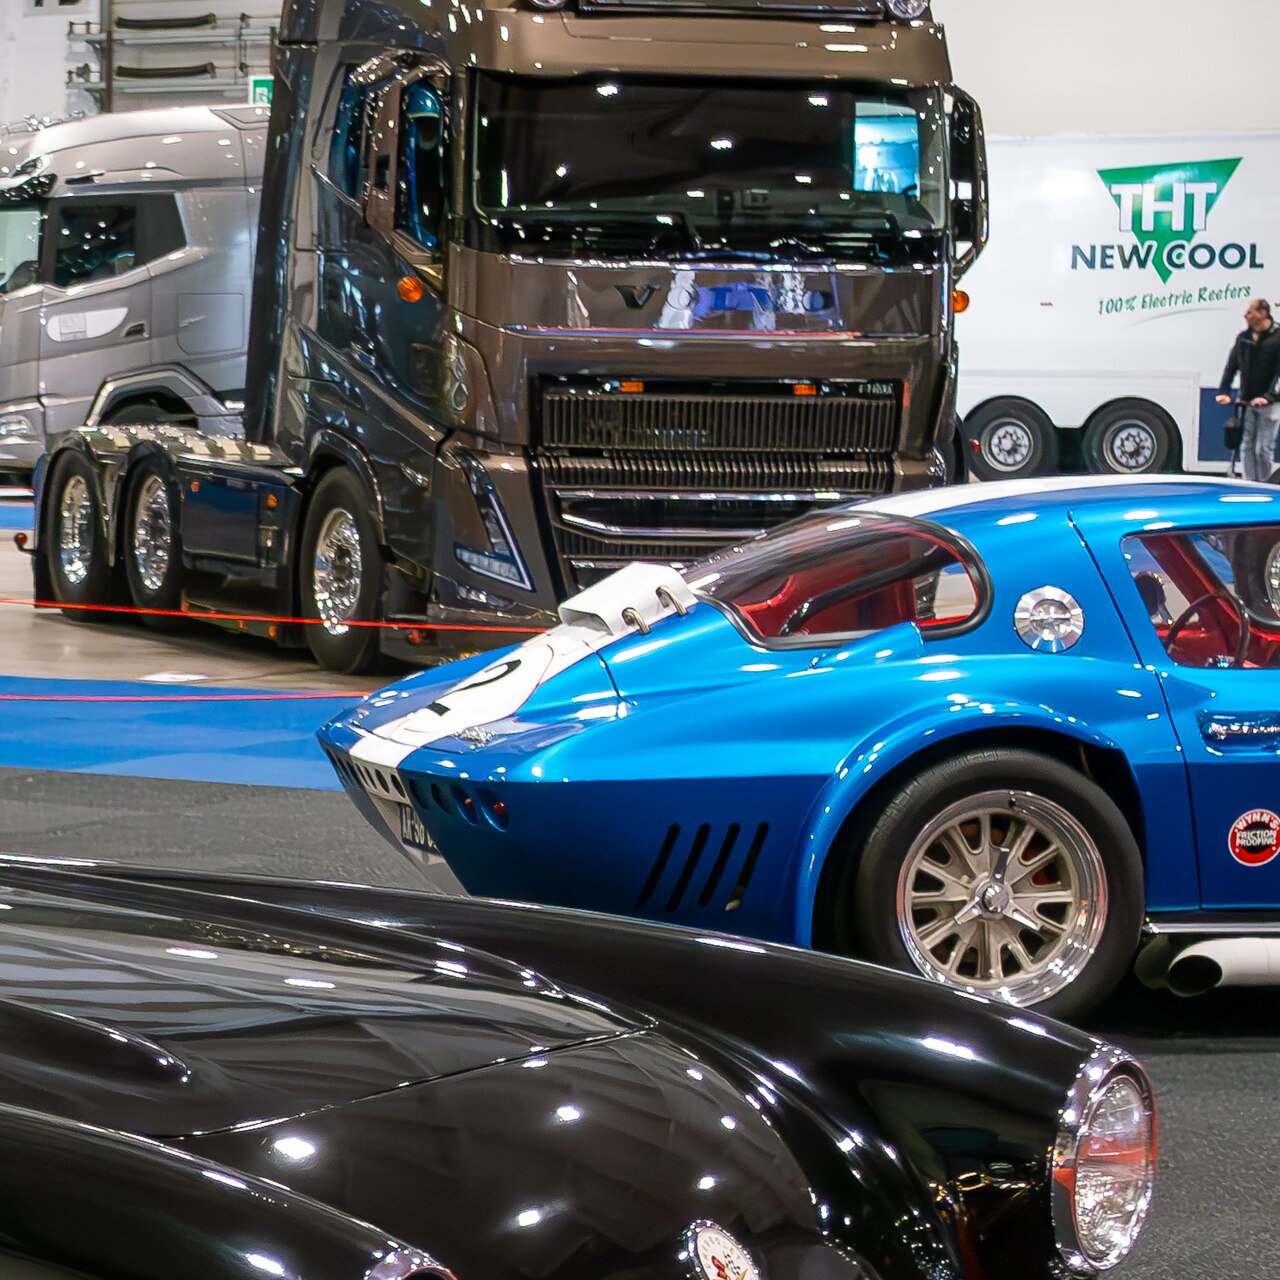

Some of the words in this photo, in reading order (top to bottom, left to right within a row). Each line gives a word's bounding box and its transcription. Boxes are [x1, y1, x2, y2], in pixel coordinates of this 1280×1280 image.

[1110, 182, 1218, 232] THT
[1071, 244, 1154, 270] NEW
[1166, 243, 1264, 270] COOL
[1098, 294, 1138, 315] 100%
[1141, 289, 1193, 310] Electric
[1198, 283, 1252, 305] Reefers
[1236, 812, 1278, 830] WYNN'S
